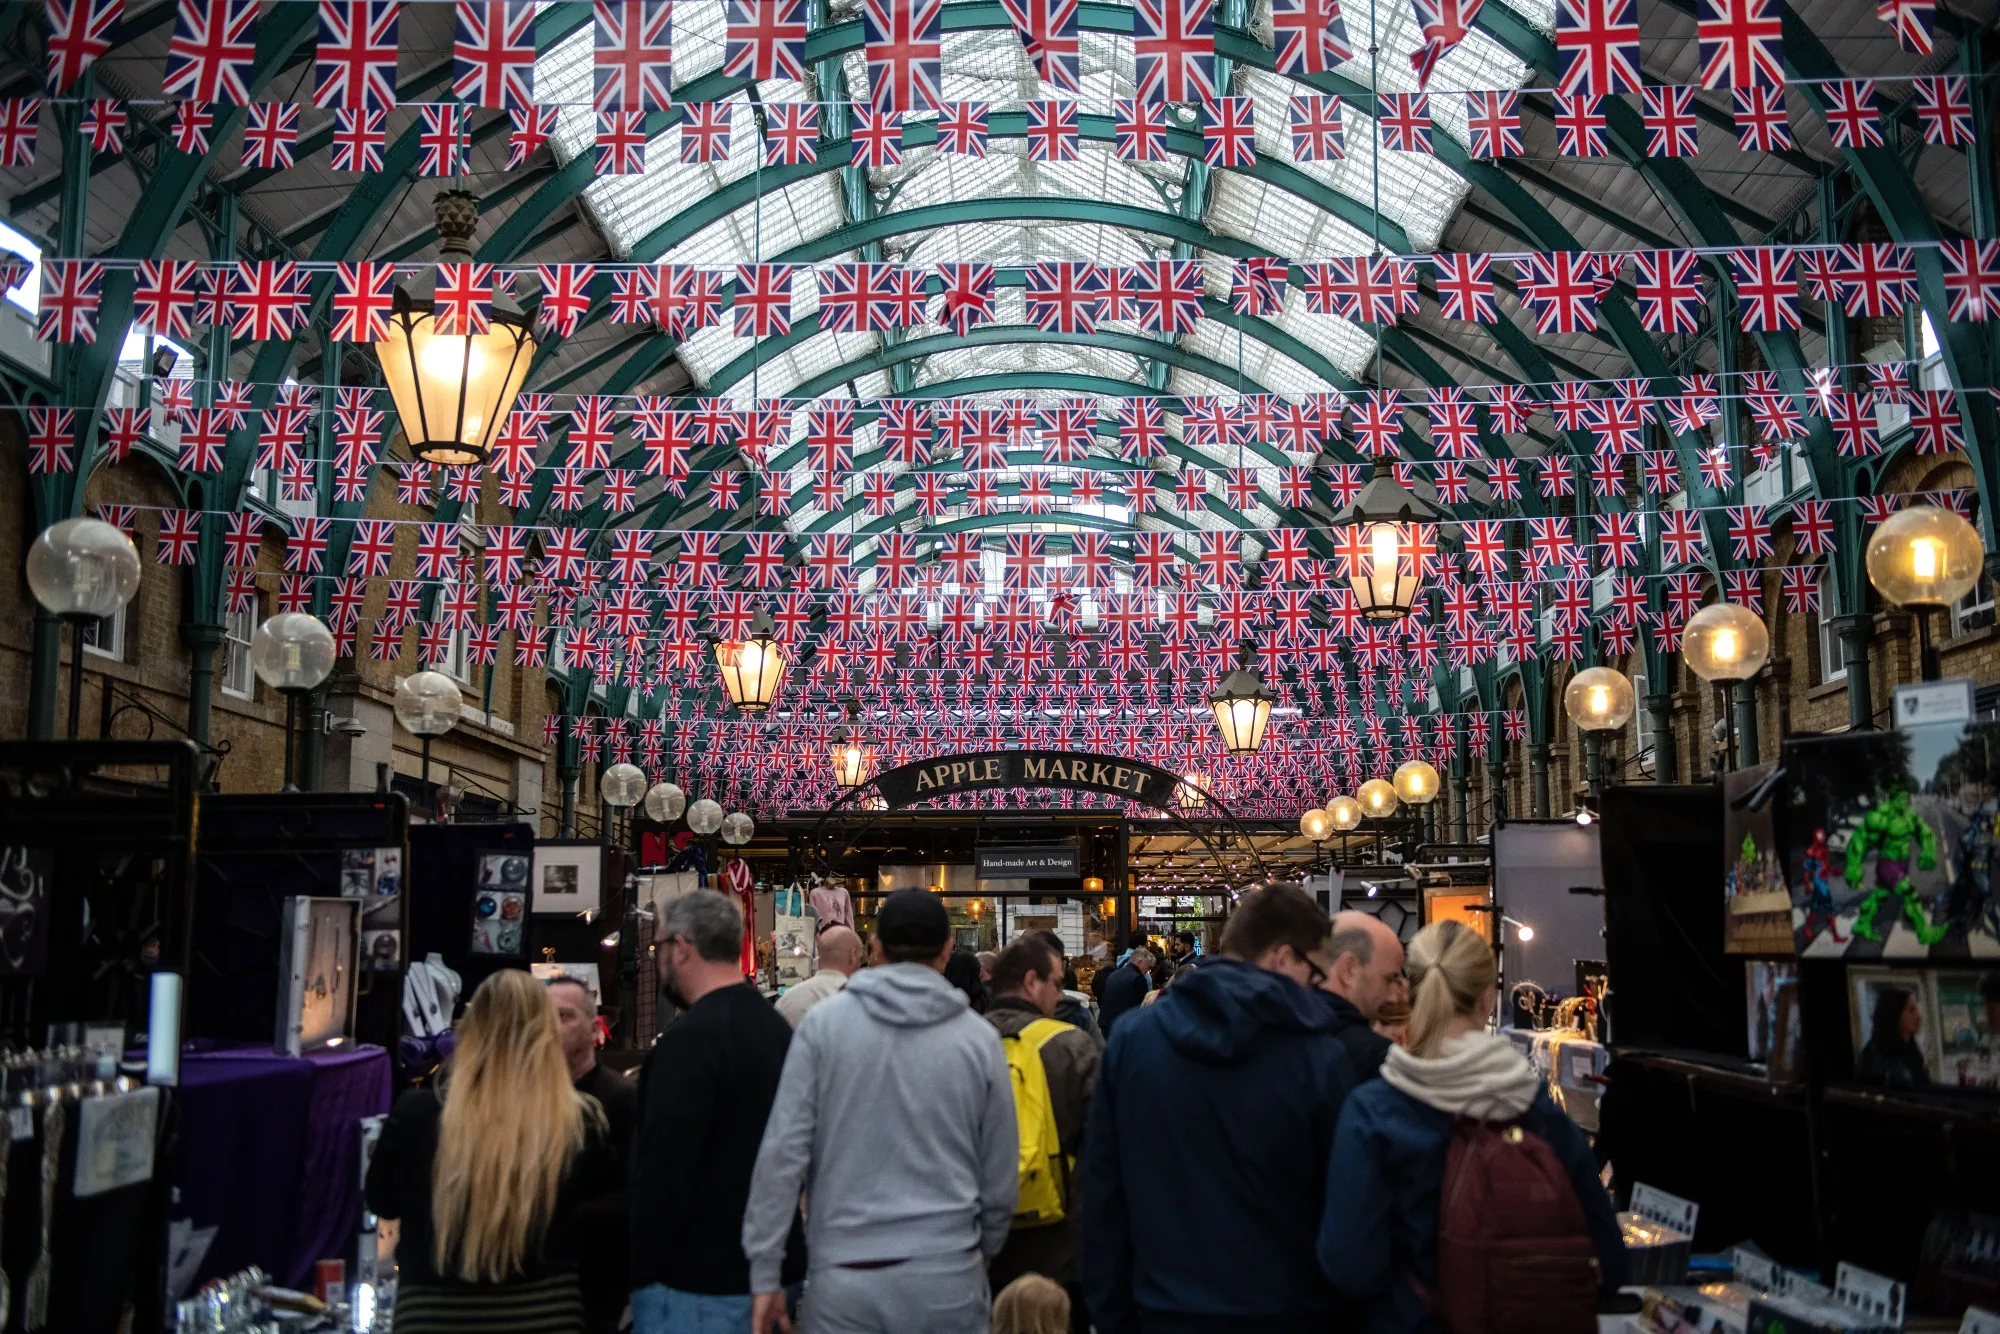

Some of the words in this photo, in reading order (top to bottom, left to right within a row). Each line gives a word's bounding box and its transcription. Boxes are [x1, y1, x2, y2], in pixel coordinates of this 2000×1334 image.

[916, 758, 1002, 793] APPLE
[1023, 758, 1151, 794] MARKET
[983, 858, 1025, 867] Hand-made
[1026, 858, 1038, 867] Art
[1039, 858, 1046, 866] &
[1047, 857, 1073, 868] Design
